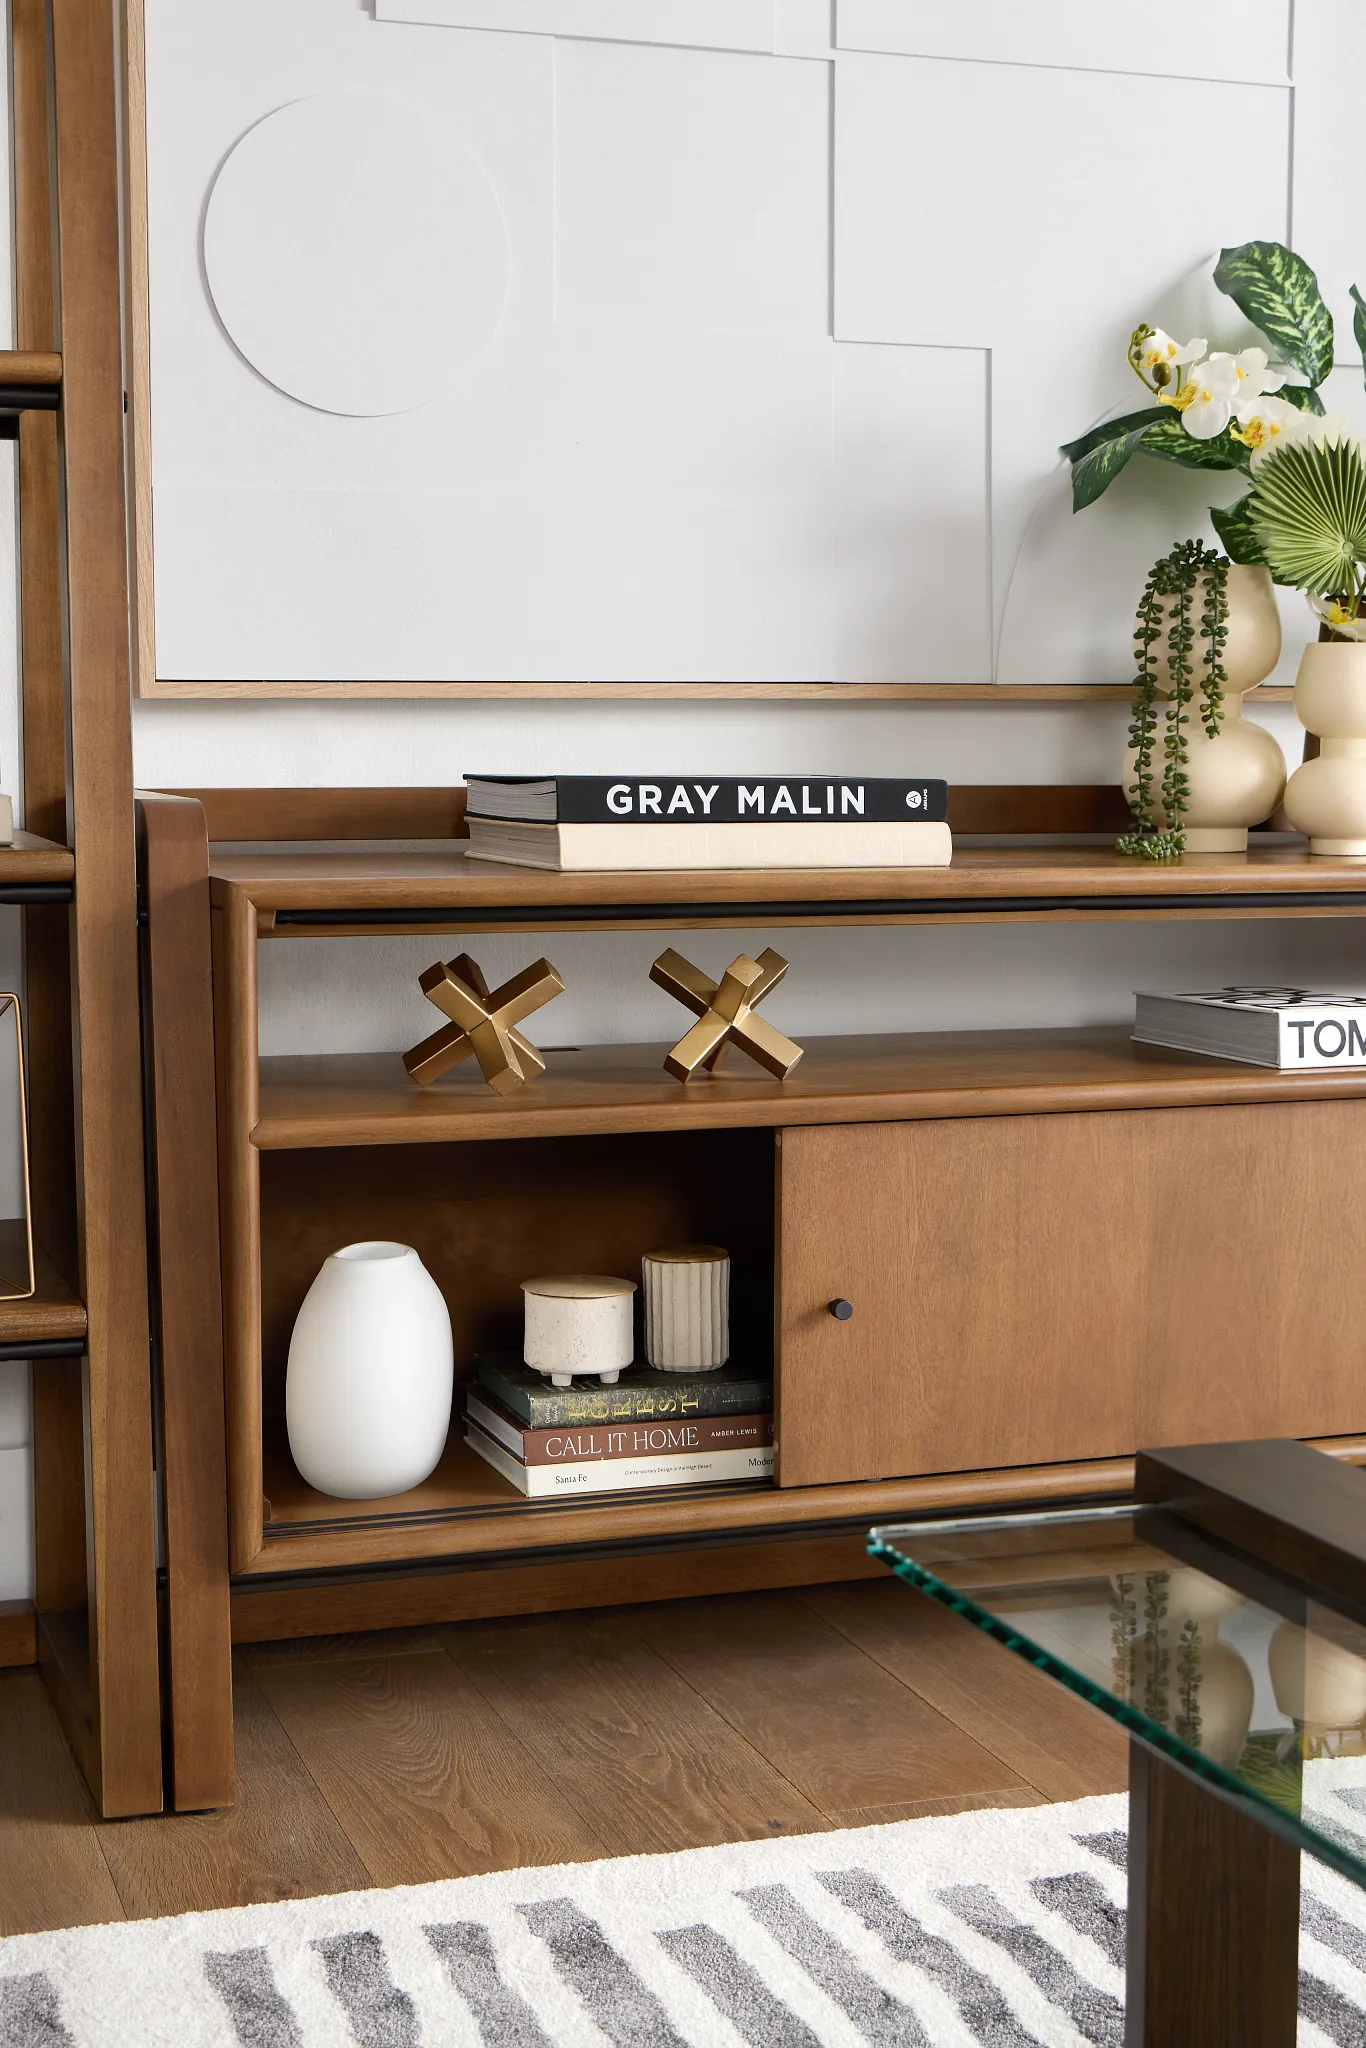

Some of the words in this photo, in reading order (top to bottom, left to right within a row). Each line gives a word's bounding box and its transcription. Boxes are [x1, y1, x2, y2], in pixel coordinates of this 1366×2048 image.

[606, 784, 720, 815] GRAY
[737, 785, 866, 815] MALIN
[1287, 1019, 1366, 1058] TOM
[568, 1394, 699, 1419] FOREST
[546, 1434, 602, 1457] CALL
[608, 1432, 628, 1453] IT
[633, 1426, 699, 1451] HOME
[711, 1430, 735, 1438] AMBER
[736, 1428, 758, 1436] LEWIS
[748, 1457, 774, 1467] Moder
[555, 1475, 577, 1484] Santa
[578, 1473, 588, 1482] Fe
